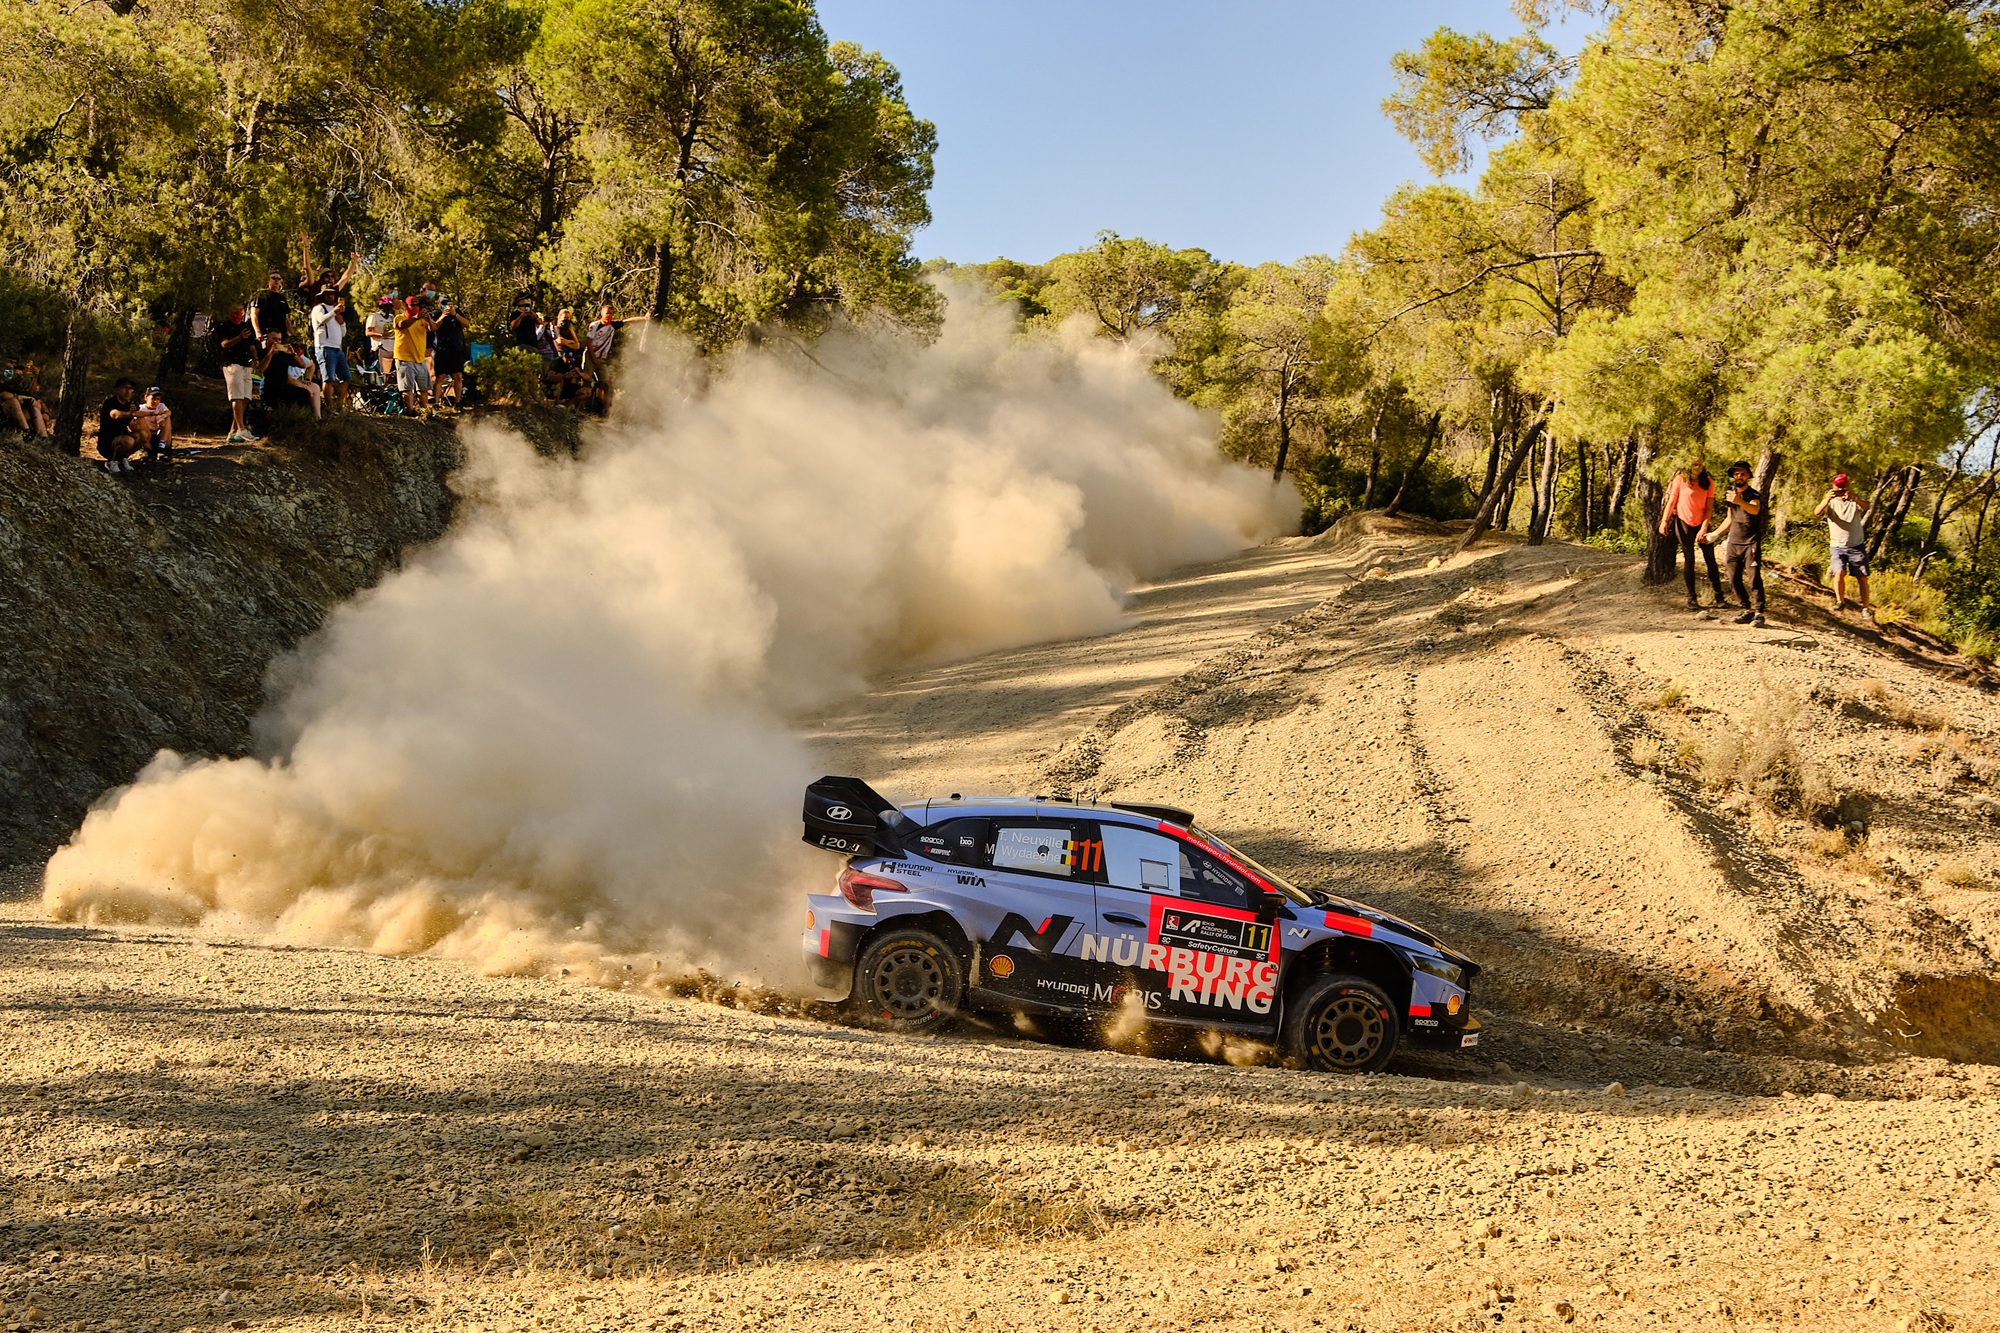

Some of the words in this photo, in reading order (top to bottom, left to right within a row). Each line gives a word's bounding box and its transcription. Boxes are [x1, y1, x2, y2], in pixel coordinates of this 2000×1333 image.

[819, 834, 847, 849] i20
[920, 836, 944, 846] sparco
[998, 830, 1008, 841] T.
[1012, 832, 1063, 849] Neuville
[1002, 844, 1060, 864] Wydaeghe
[1080, 839, 1102, 872] 11
[1186, 835, 1262, 884] motorsport.hyundai.com
[896, 868, 922, 877] STEEL
[898, 862, 933, 872] HYUNDAI
[1211, 867, 1234, 886] HYUNDAI
[1201, 926, 1228, 934] ACROPOLIS
[1248, 925, 1268, 950] 11
[1188, 940, 1238, 956] SafetyCulture
[1080, 934, 1278, 992] NÜRBURG
[1037, 979, 1090, 995] HYUNDAI
[1170, 973, 1275, 1014] RING
[1414, 1018, 1438, 1026] sparco
